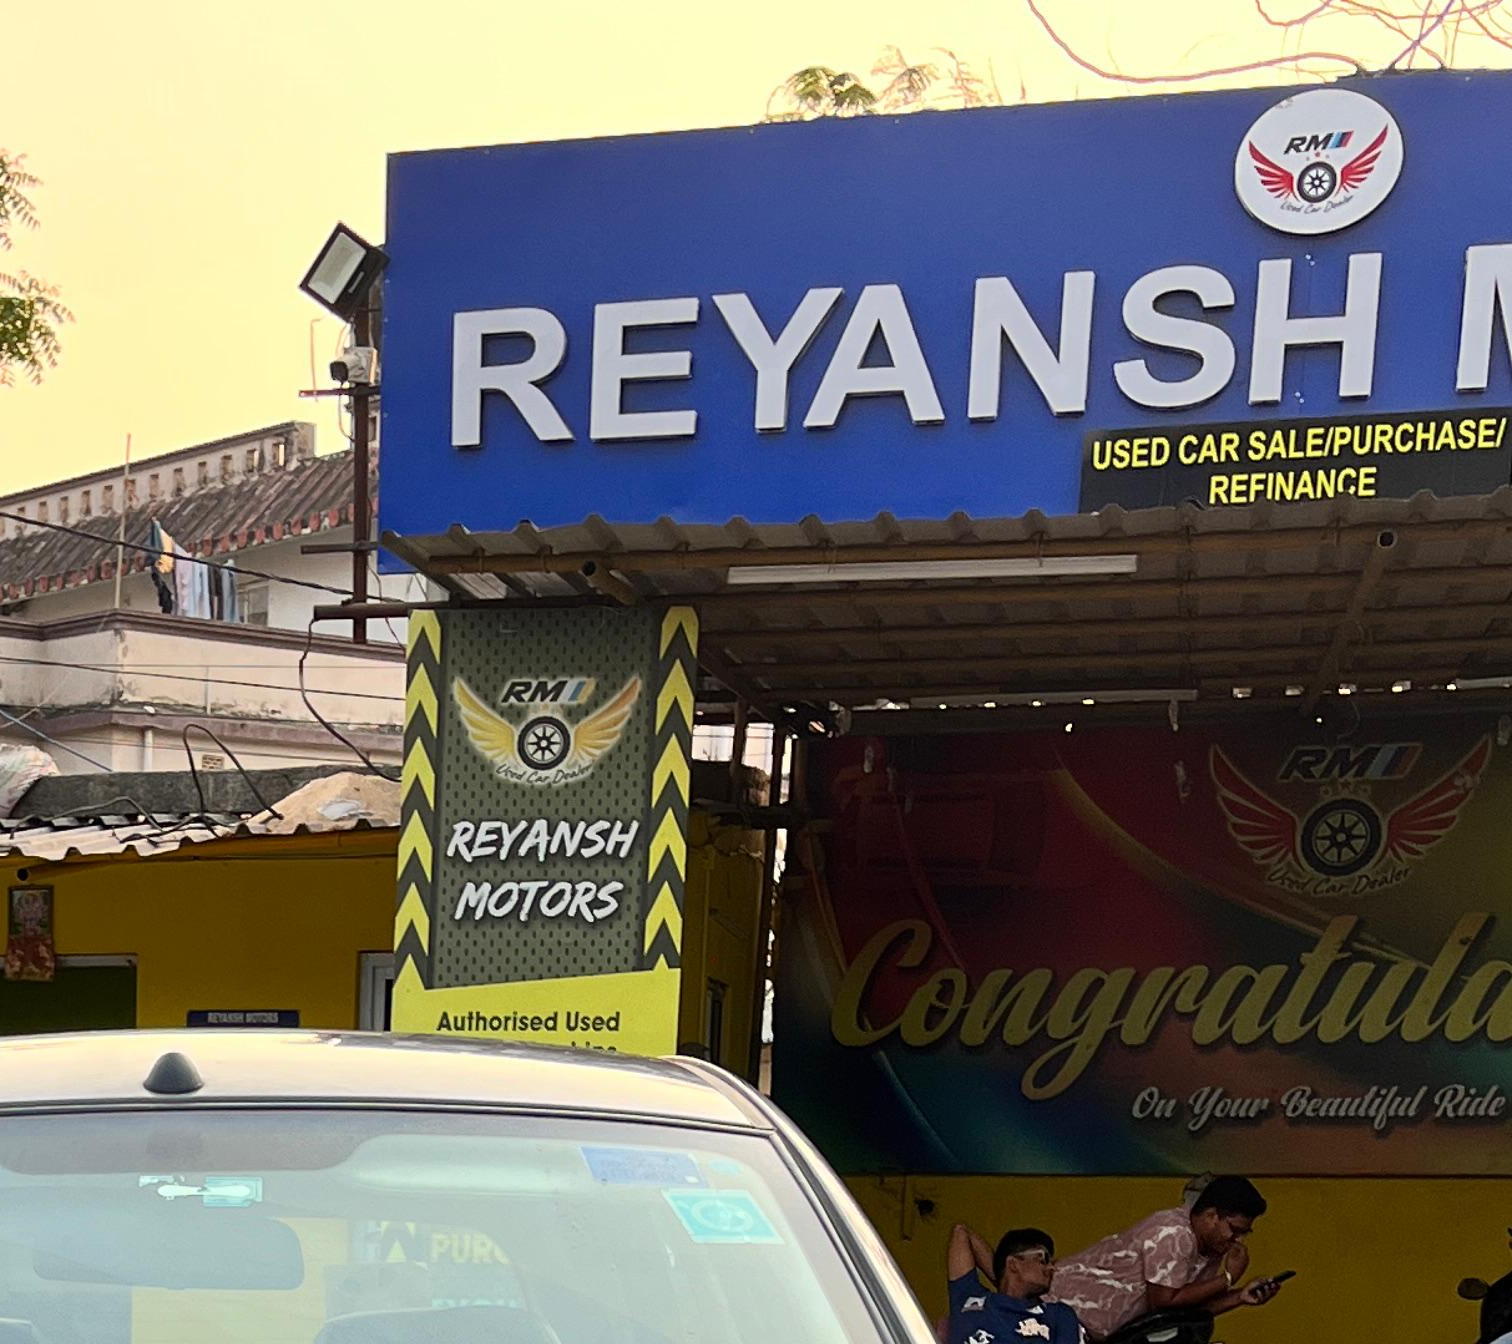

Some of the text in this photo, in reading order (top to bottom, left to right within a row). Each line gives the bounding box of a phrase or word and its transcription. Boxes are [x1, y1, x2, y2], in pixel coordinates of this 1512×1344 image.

[450, 252, 1383, 449] REYANSH
[1092, 436, 1170, 470] USED
[1177, 431, 1240, 464] CAR
[1209, 467, 1378, 504] REFINANCE
[445, 818, 640, 863] REYANSH
[1313, 878, 1345, 895] Car
[1352, 866, 1412, 895] Dealer
[453, 880, 624, 924] MOTORS
[436, 1011, 620, 1032] Authorised Used
[1132, 1083, 1506, 1131] On Your Beautiful Ride
